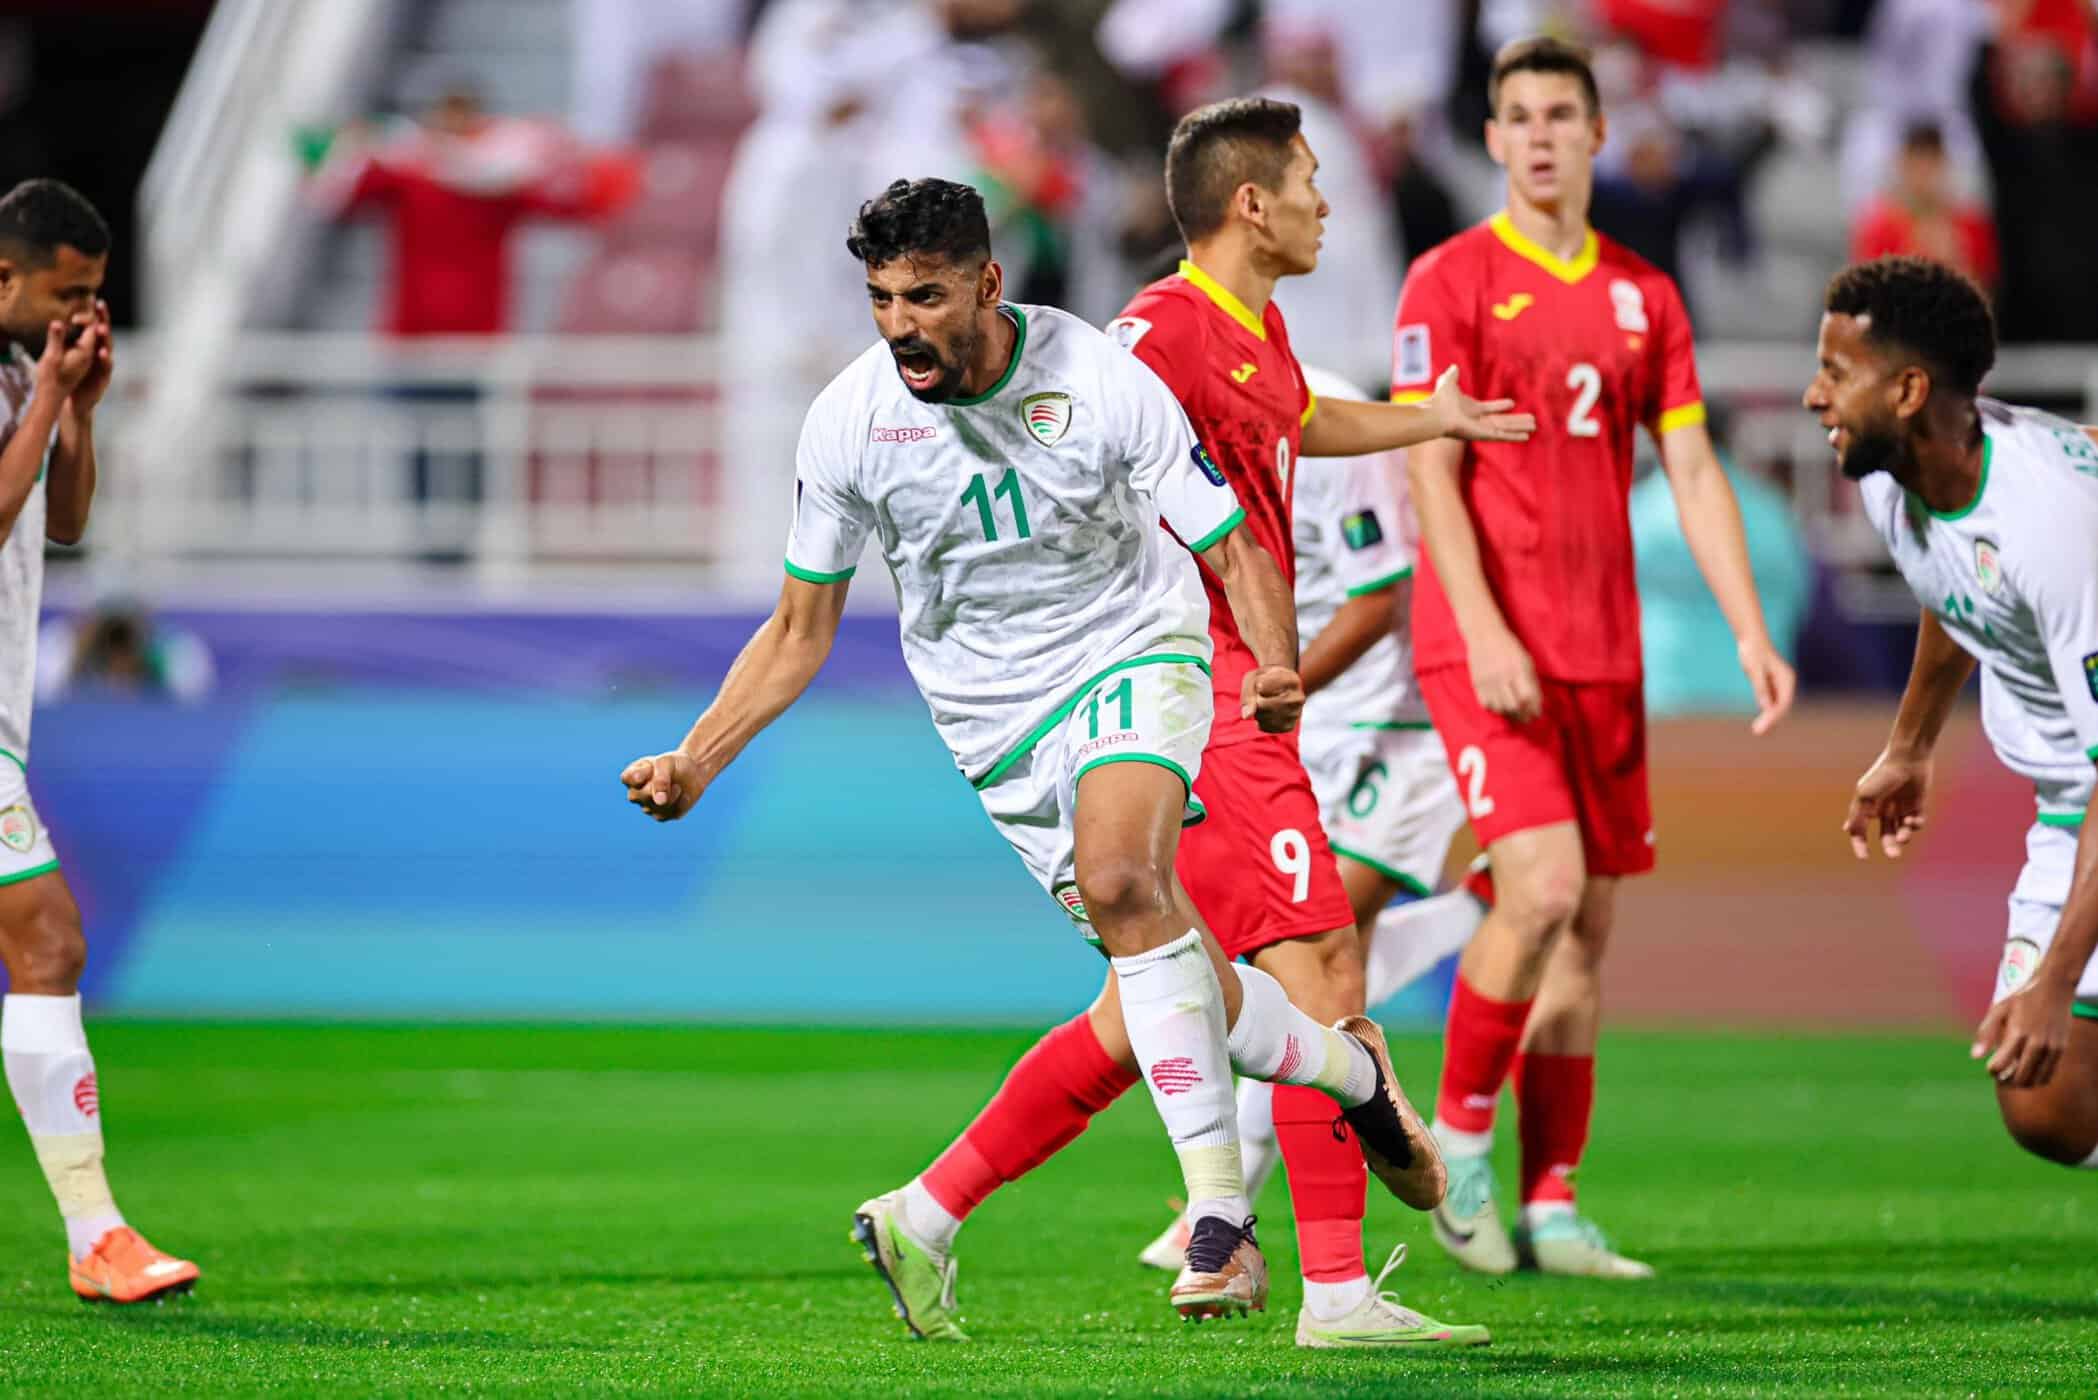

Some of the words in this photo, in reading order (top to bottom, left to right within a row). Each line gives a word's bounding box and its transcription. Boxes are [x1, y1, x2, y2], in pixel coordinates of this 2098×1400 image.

[872, 425, 937, 443] Kappa
[1566, 363, 1601, 436] 2
[960, 467, 1031, 542] 11
[1276, 436, 1290, 504] 9
[1079, 678, 1132, 740] 11
[1346, 760, 1388, 820] 6
[1457, 745, 1494, 818] 2
[1269, 828, 1310, 903] 9
